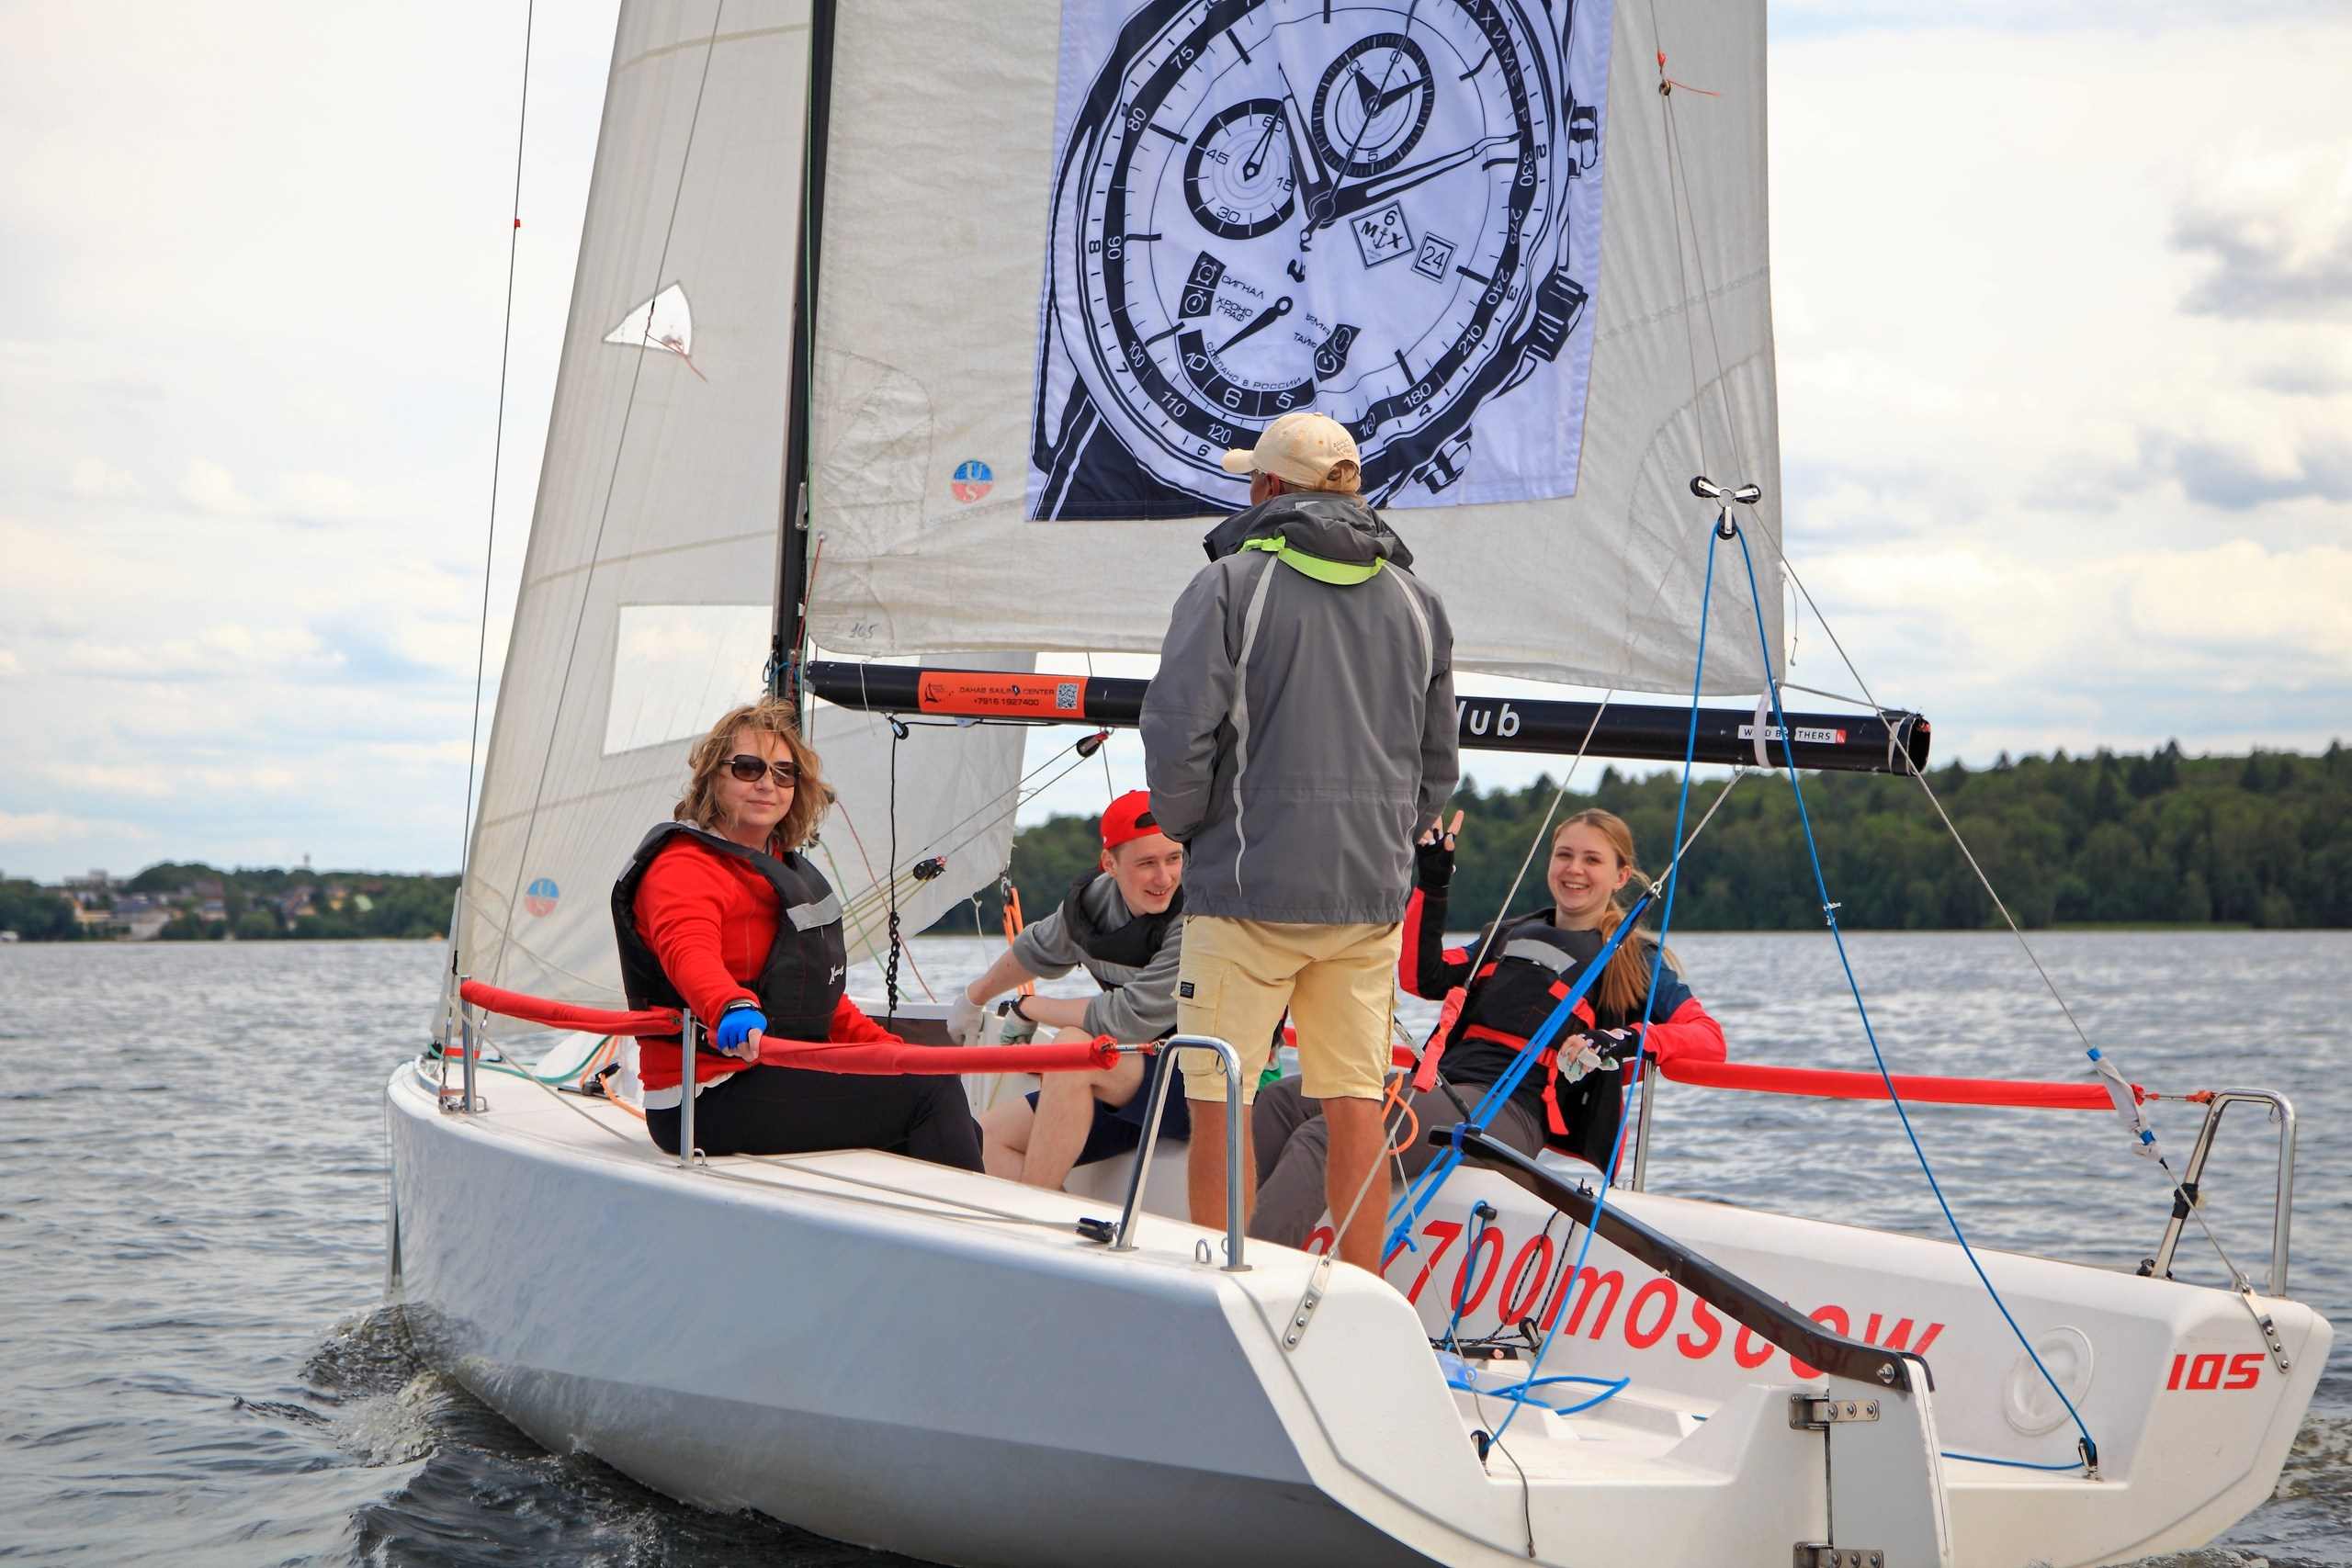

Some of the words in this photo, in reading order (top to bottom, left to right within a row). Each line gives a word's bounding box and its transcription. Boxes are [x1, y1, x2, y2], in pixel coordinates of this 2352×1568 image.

[1170, 46, 1194, 69] 75
[1127, 107, 1147, 131] 80
[1206, 149, 1230, 165] 45
[1535, 144, 1547, 160] 2
[1520, 151, 1534, 186] 330
[1216, 206, 1241, 223] 30
[1384, 210, 1397, 226] 6
[1089, 240, 1101, 254] 8
[1107, 236, 1122, 260] 90
[1420, 246, 1445, 270] 24
[1221, 275, 1264, 299] СИГНАЛ
[1486, 268, 1510, 305] 240
[1216, 297, 1253, 317] ХРОНО
[1216, 305, 1245, 321] ГРАФ
[1458, 324, 1483, 356] 210
[1129, 341, 1146, 367] 100
[1186, 352, 1209, 371] 10
[1206, 342, 1239, 382] СДЕЛАНО
[1253, 377, 1302, 390] РОССИИ
[1161, 391, 1188, 418] 110
[1223, 387, 1243, 409] 6
[1276, 391, 1295, 410] 5
[1403, 382, 1432, 408] 180
[1207, 423, 1232, 444] 120
[1360, 412, 1376, 437] 160
[1197, 444, 1211, 457] 6
[1001, 698, 1039, 706] 1927400
[1458, 701, 1520, 738] lub
[2166, 1353, 2267, 1391] 105
